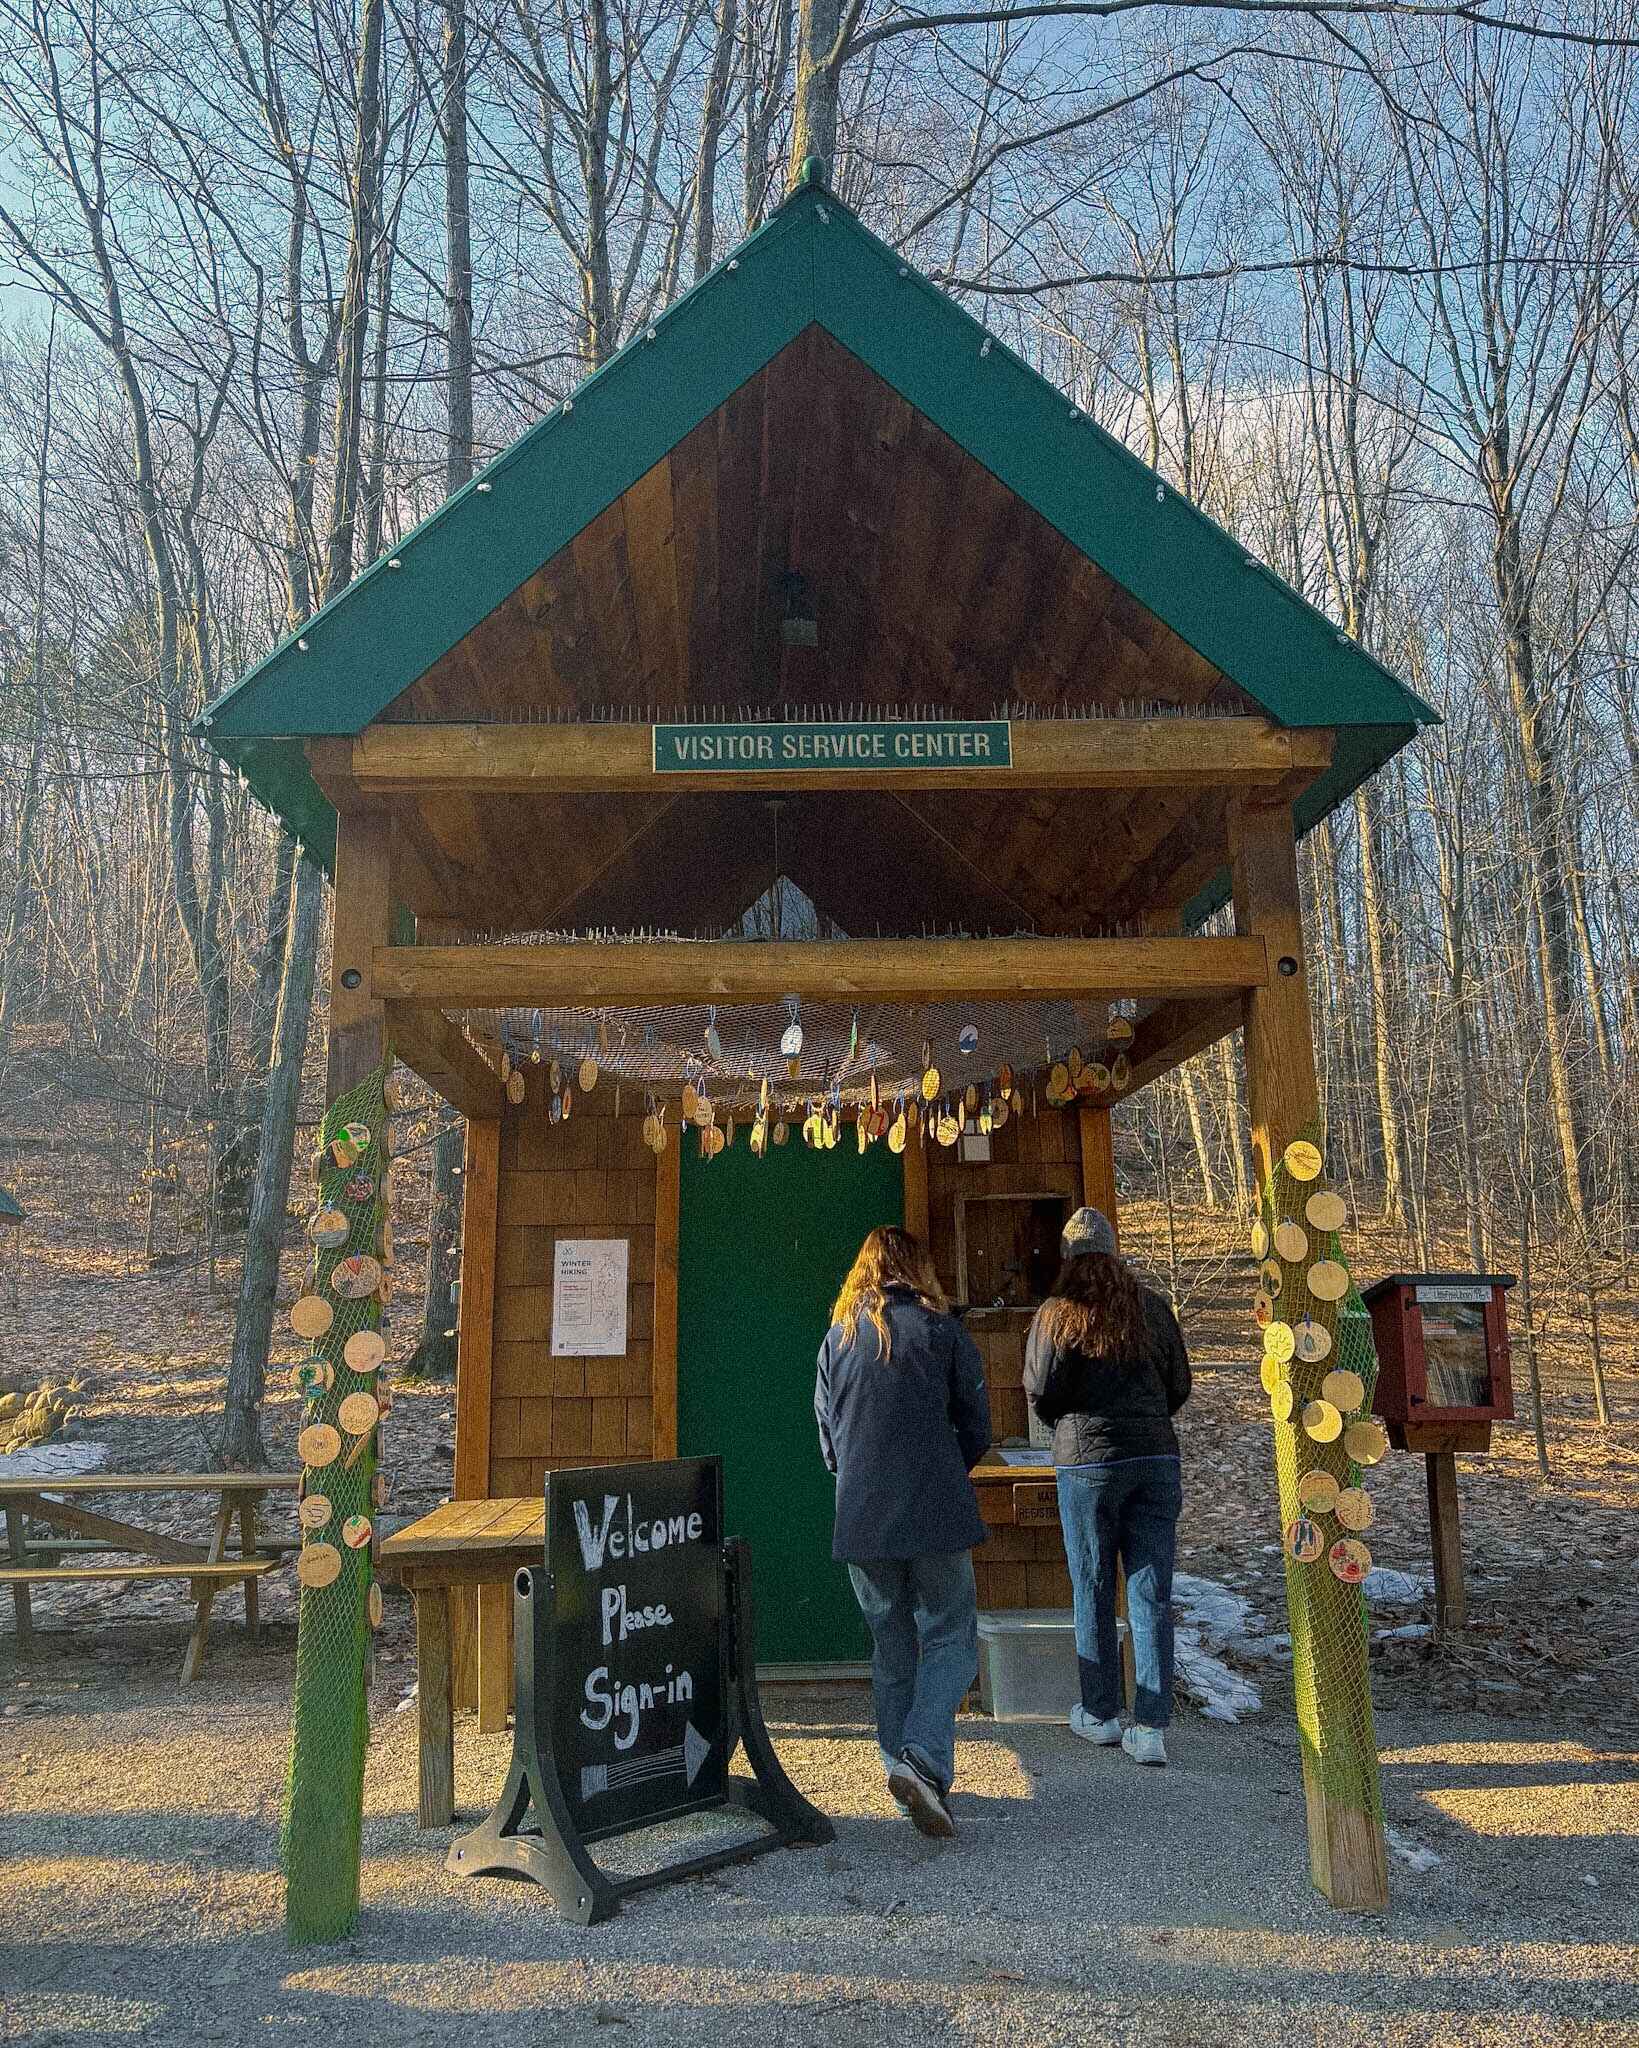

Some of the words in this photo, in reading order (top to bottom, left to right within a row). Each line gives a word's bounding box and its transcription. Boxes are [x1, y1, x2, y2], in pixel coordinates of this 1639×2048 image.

[674, 735, 774, 760] VISITOR
[782, 733, 886, 759] SERVICE
[895, 732, 991, 758] CENTER
[573, 1492, 704, 1571] Welcome
[601, 1584, 674, 1646] Please
[580, 1663, 693, 1750] Sign-in
